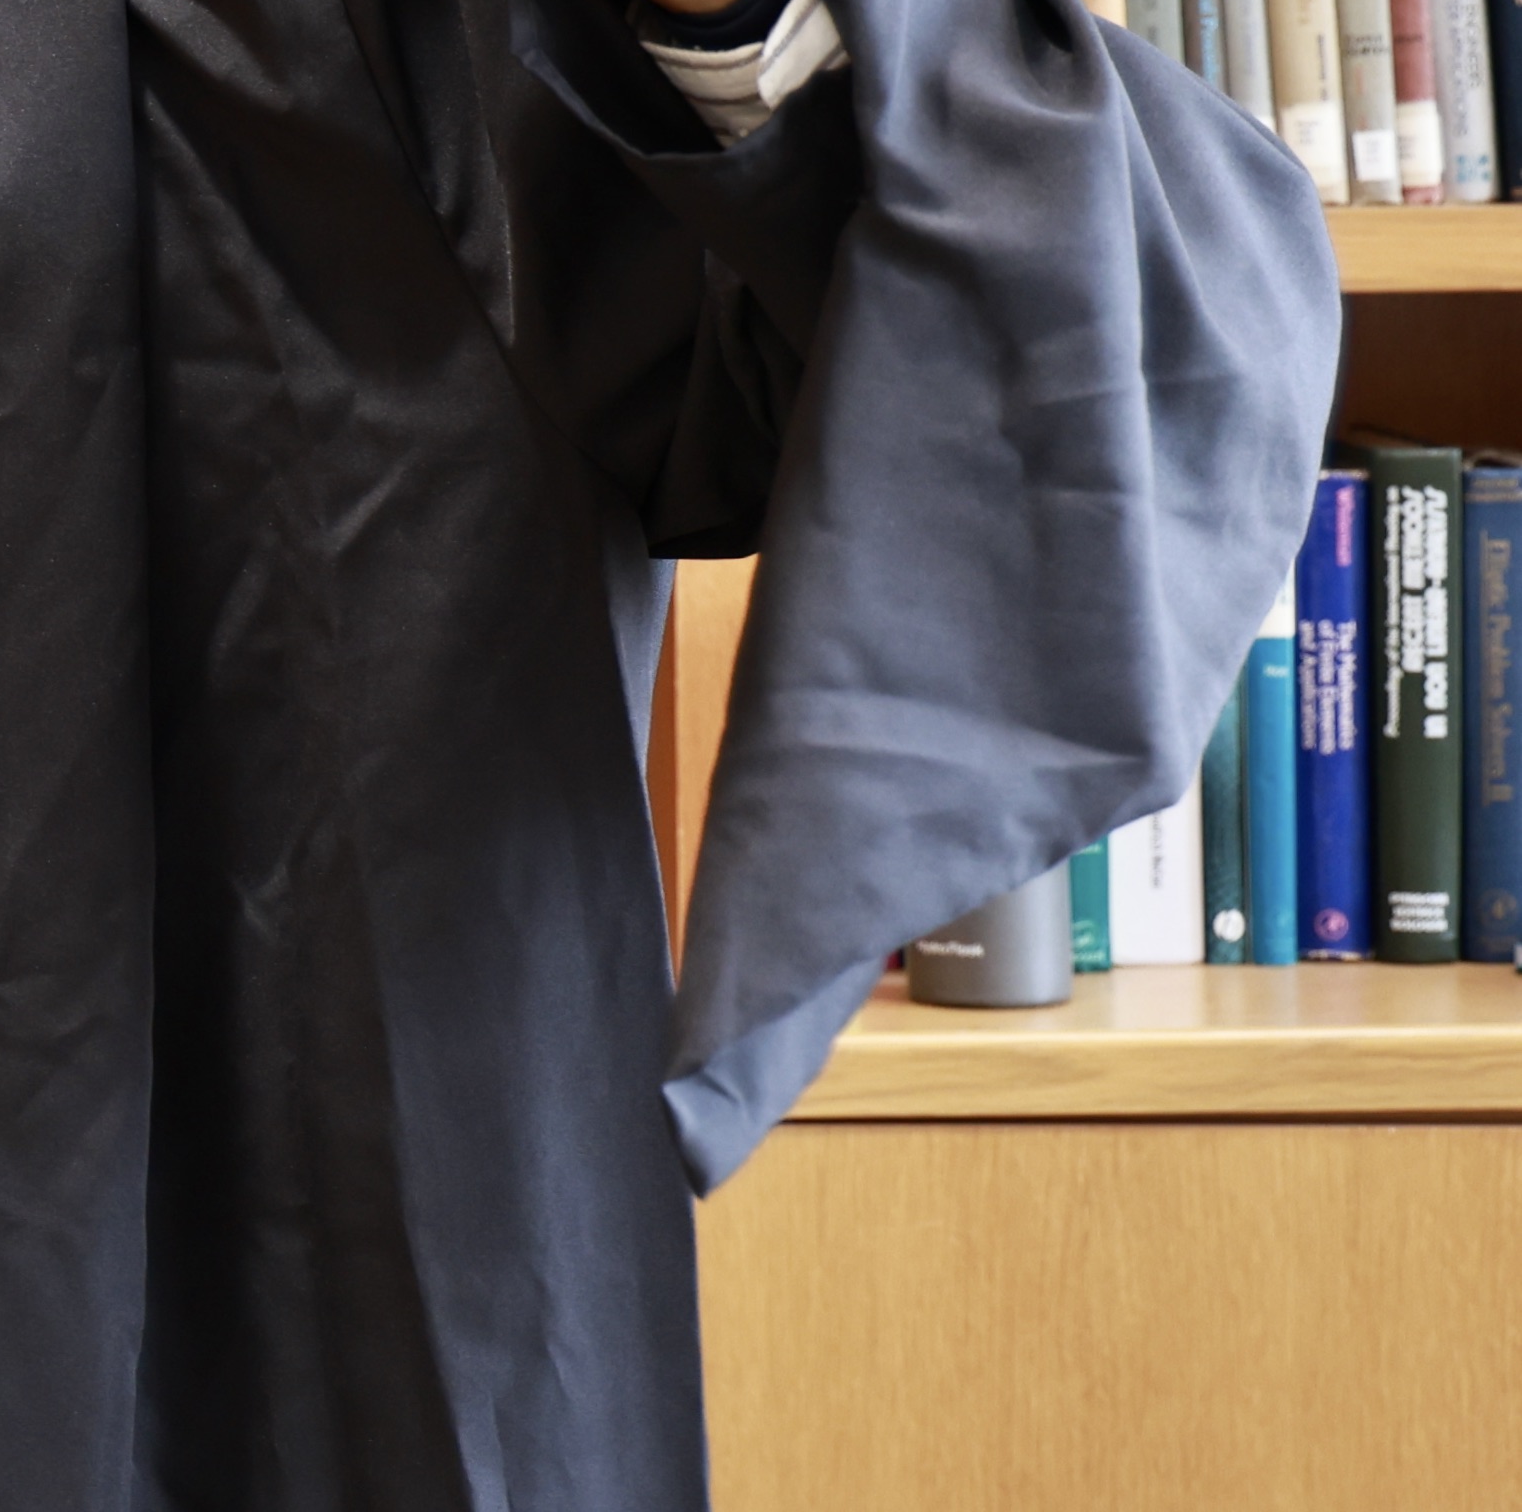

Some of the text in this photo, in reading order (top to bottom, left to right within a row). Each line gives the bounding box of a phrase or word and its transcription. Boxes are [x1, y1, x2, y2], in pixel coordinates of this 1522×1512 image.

[1447, 26, 1468, 138] APPLICATIONS
[1464, 3, 1482, 89] ENGINEERS
[1334, 485, 1355, 567] Whiteman
[1401, 486, 1425, 589] METHODS
[1486, 538, 1511, 607] Elliptic
[1298, 619, 1320, 750] and Applications
[1319, 619, 1338, 755] of Finite Elements
[1337, 619, 1358, 750] The Mathematics
[1487, 613, 1512, 697] Problem
[1490, 702, 1512, 777] Solvers
